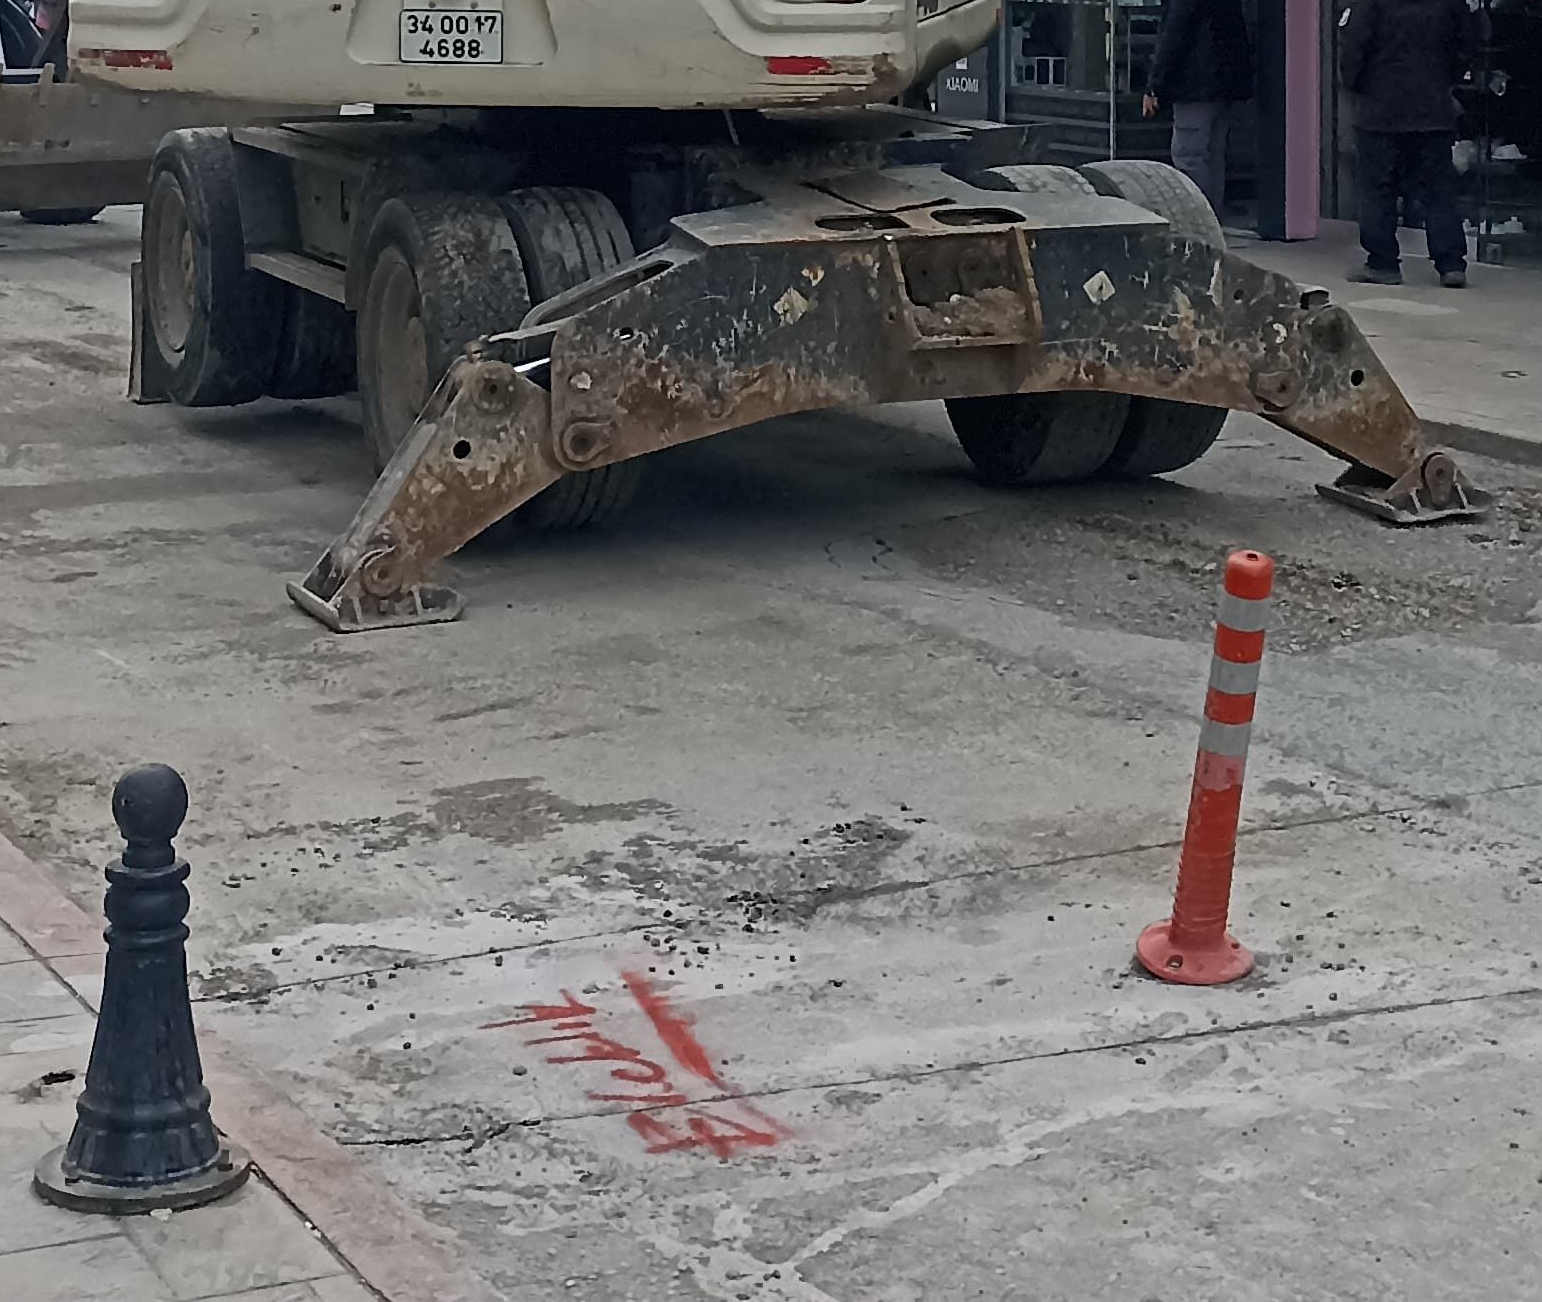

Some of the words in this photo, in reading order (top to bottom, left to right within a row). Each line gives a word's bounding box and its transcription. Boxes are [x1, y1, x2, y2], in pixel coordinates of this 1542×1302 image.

[407, 14, 434, 34] 34
[475, 15, 497, 34] 17
[419, 38, 481, 58] 4688
